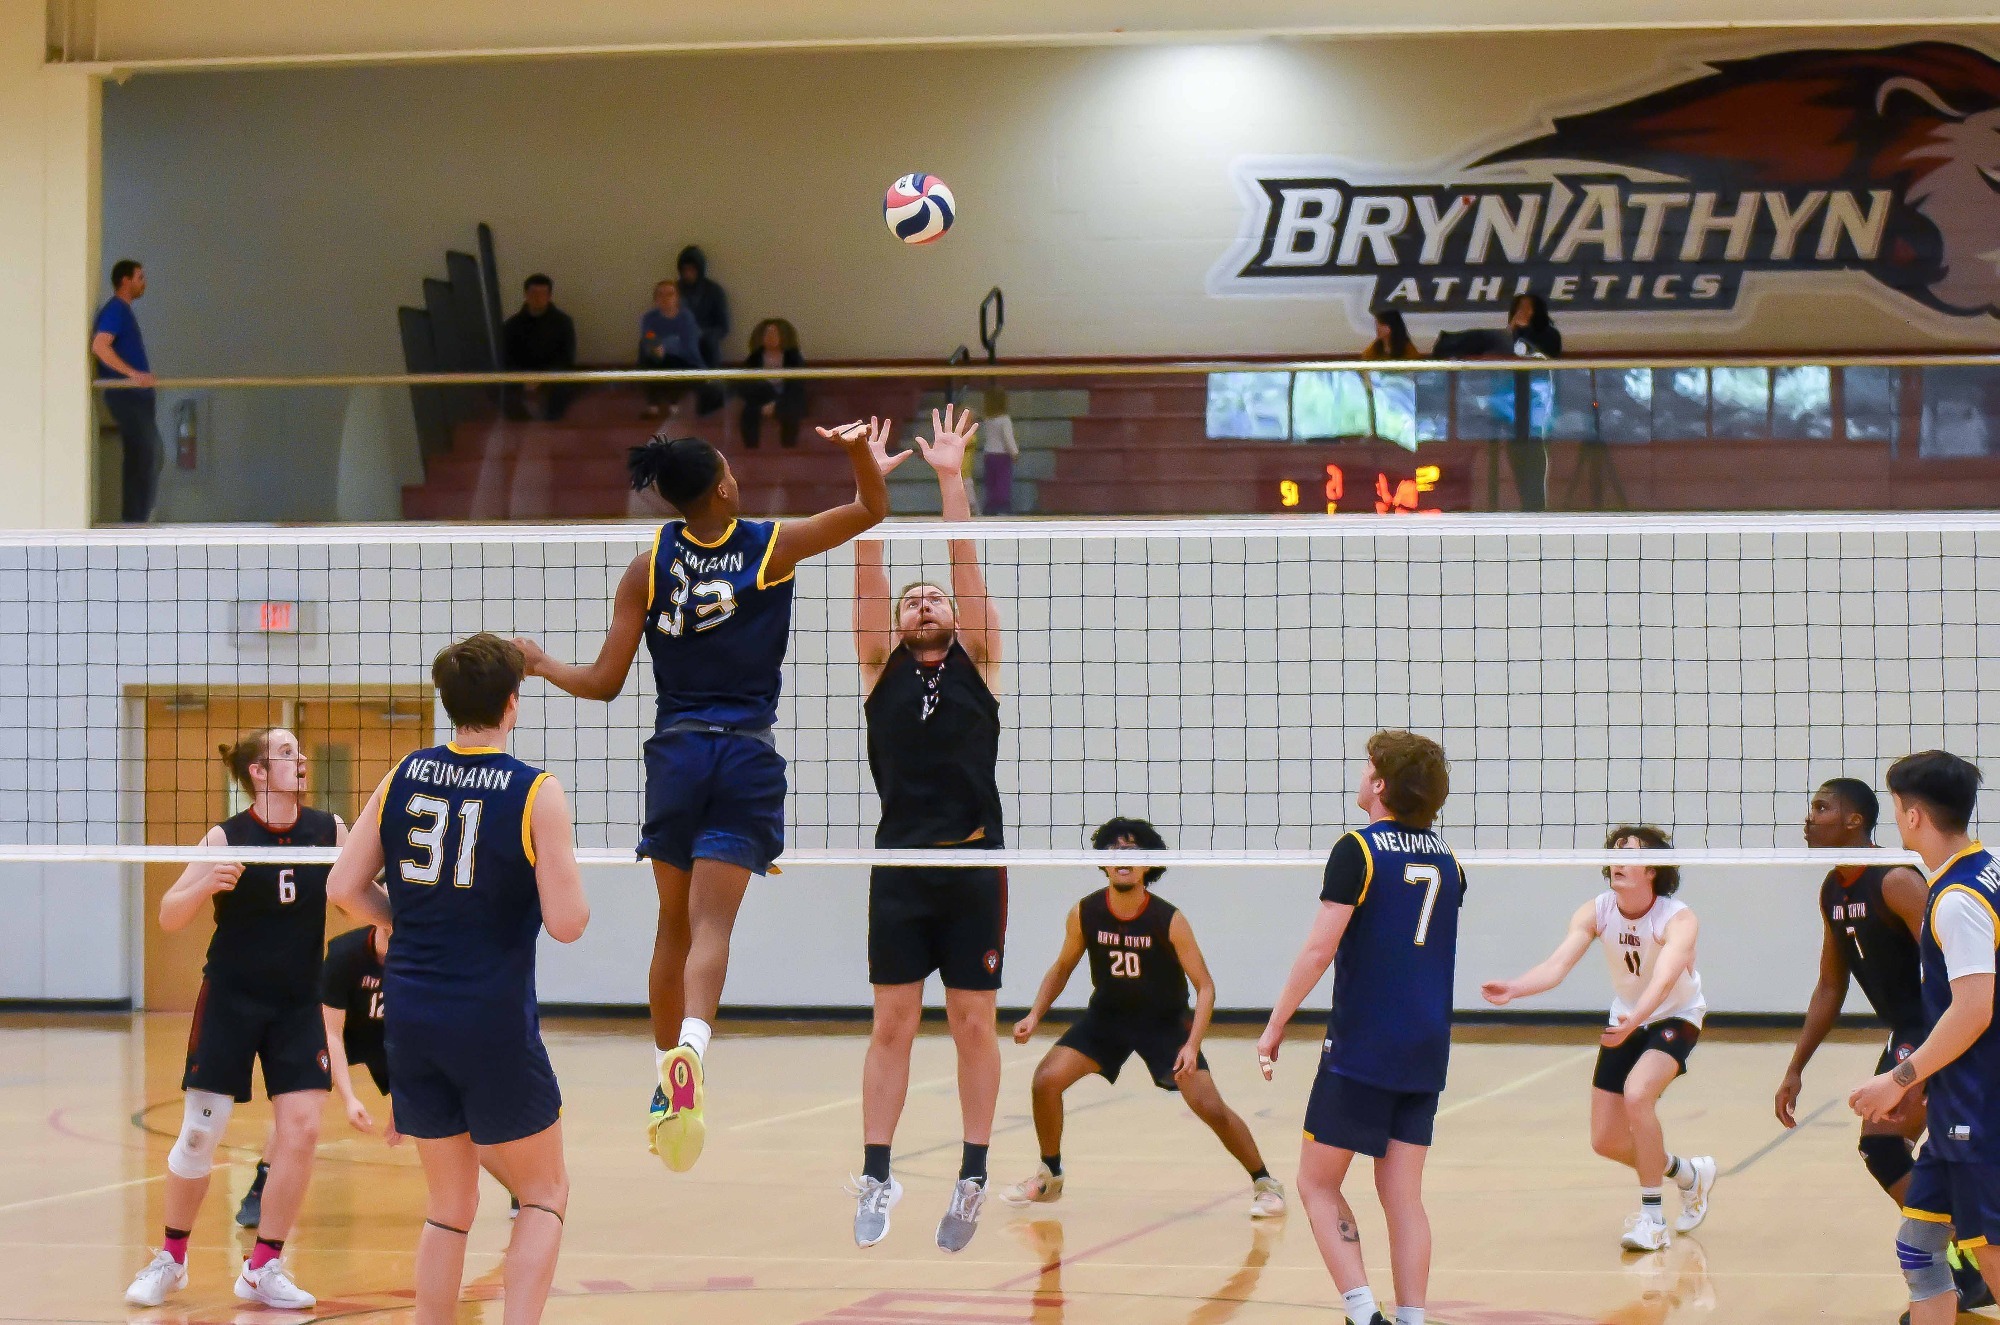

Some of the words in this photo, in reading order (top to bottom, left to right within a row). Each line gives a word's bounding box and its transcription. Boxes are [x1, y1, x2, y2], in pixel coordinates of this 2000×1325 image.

[404, 757, 513, 791] NEUMANN
[399, 793, 483, 888] 31
[279, 868, 296, 904] 6
[1403, 863, 1442, 946] 7
[1845, 926, 1864, 959] 7
[1109, 950, 1141, 978] 20
